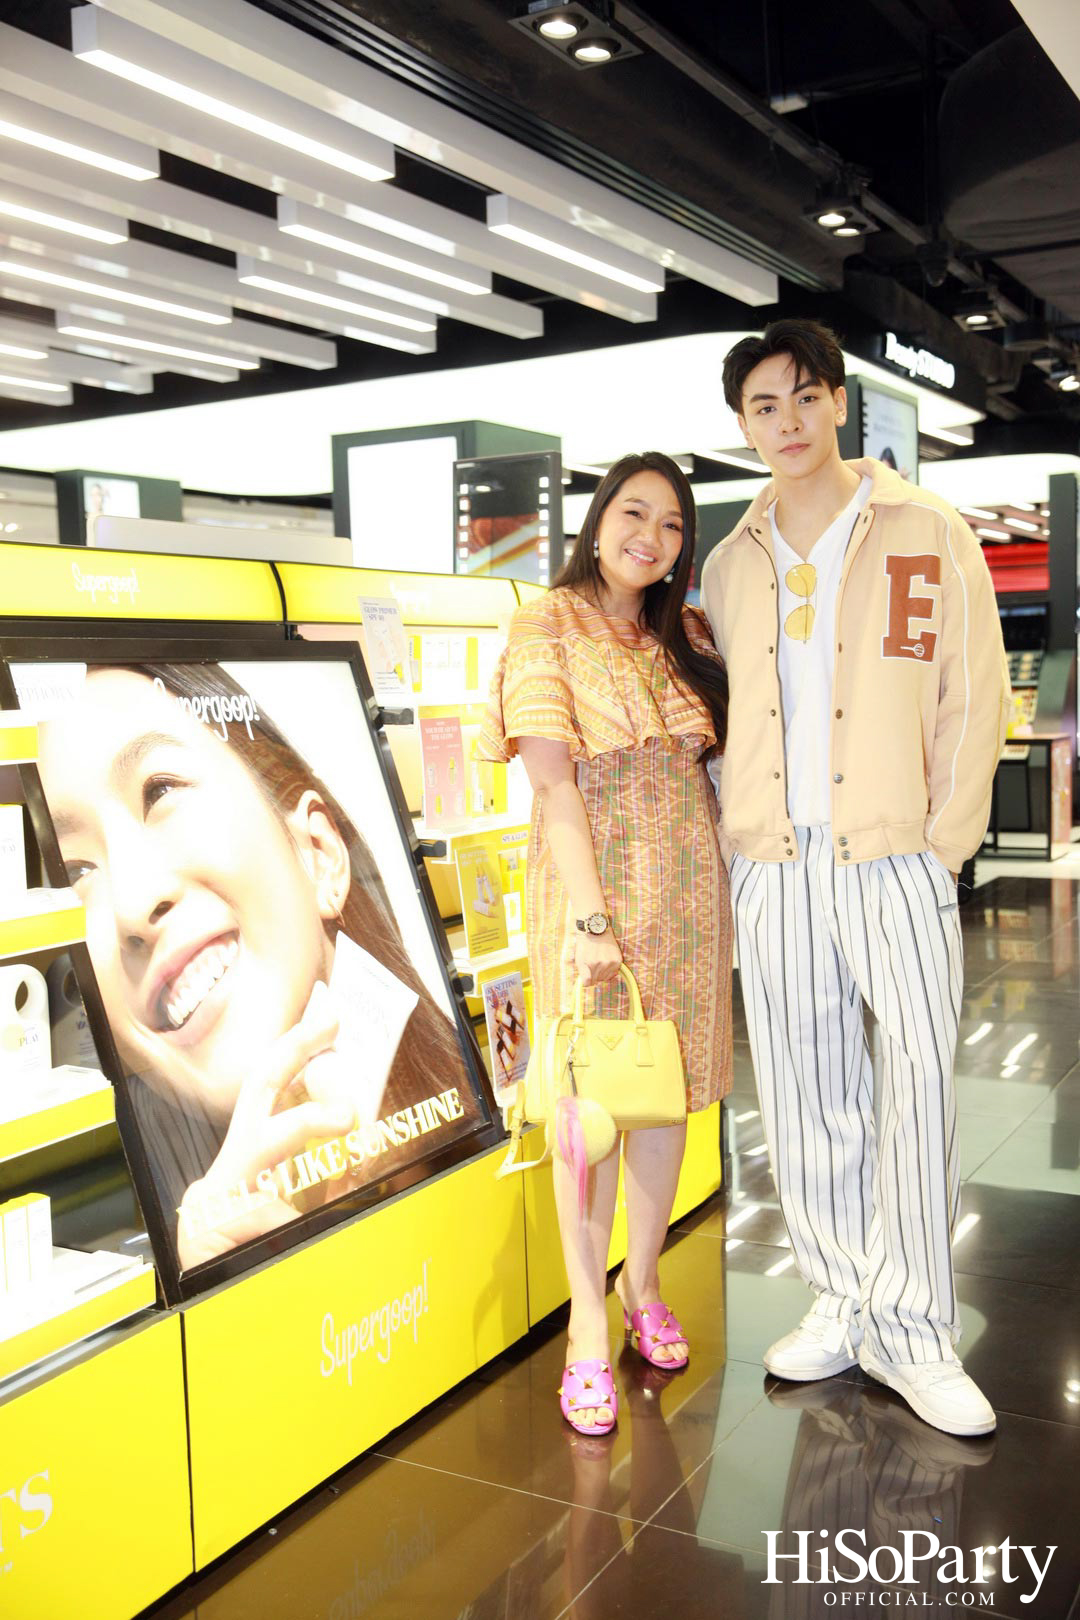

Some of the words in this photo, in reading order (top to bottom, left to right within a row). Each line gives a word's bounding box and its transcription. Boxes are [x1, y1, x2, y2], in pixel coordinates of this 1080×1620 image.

[71, 562, 140, 605] Supergoop!
[881, 553, 941, 664] E
[153, 677, 260, 742] pergoop!
[281, 1140, 347, 1194] LIKE
[347, 1088, 464, 1167] SUNSHINE
[320, 1263, 430, 1386] Supergoop!
